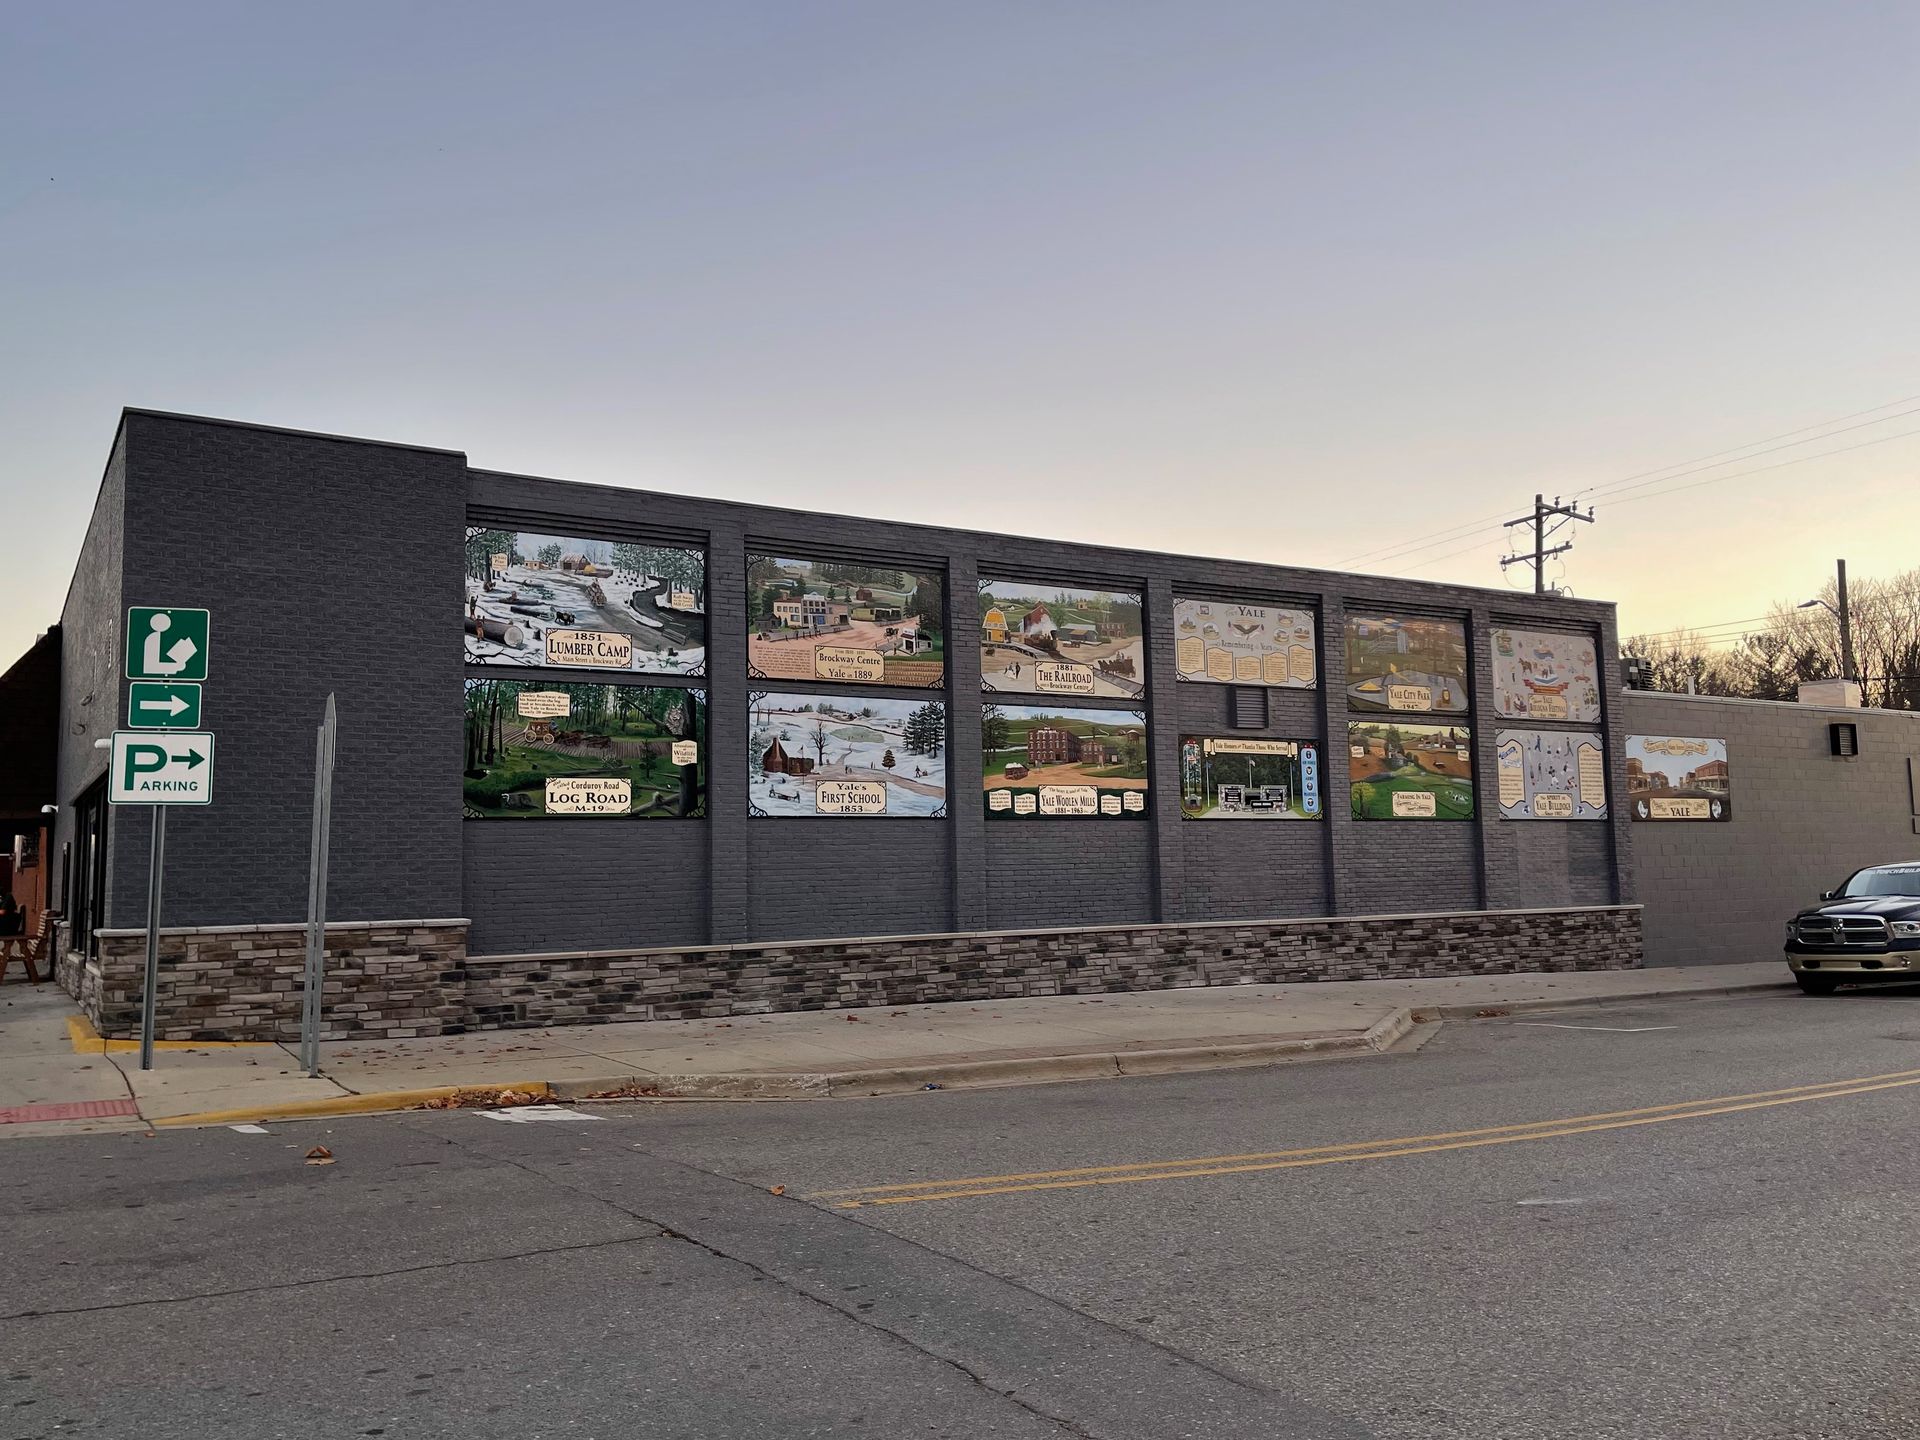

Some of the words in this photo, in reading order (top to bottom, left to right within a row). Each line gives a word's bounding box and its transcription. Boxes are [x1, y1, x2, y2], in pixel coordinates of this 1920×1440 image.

[1238, 606, 1265, 618] YALE
[574, 632, 602, 642] 1851
[549, 639, 594, 656] LUMBER
[597, 642, 630, 657] CAMP
[819, 653, 855, 665] Brockway
[857, 656, 881, 665] Centre
[828, 668, 846, 678] Yale
[854, 670, 873, 679] 1889
[1038, 670, 1053, 682] THE
[1054, 671, 1092, 684] RAILROAD
[1049, 682, 1072, 690] Brockway
[1389, 688, 1403, 699] YALE
[1403, 689, 1416, 699] CITY
[1417, 690, 1430, 700] PARK
[124, 744, 198, 791] PARKING
[571, 781, 602, 791] Corduroy
[603, 781, 620, 790] Road
[837, 783, 867, 791] Yale's
[549, 792, 580, 804] LOG
[585, 792, 628, 804] ROAD
[821, 790, 846, 803] FIRST
[848, 791, 882, 804] SCHOOL
[1041, 794, 1055, 806] YALE
[1055, 795, 1079, 807] WOOLEN
[1079, 795, 1096, 807] MILLS
[1670, 807, 1690, 816] YALE
